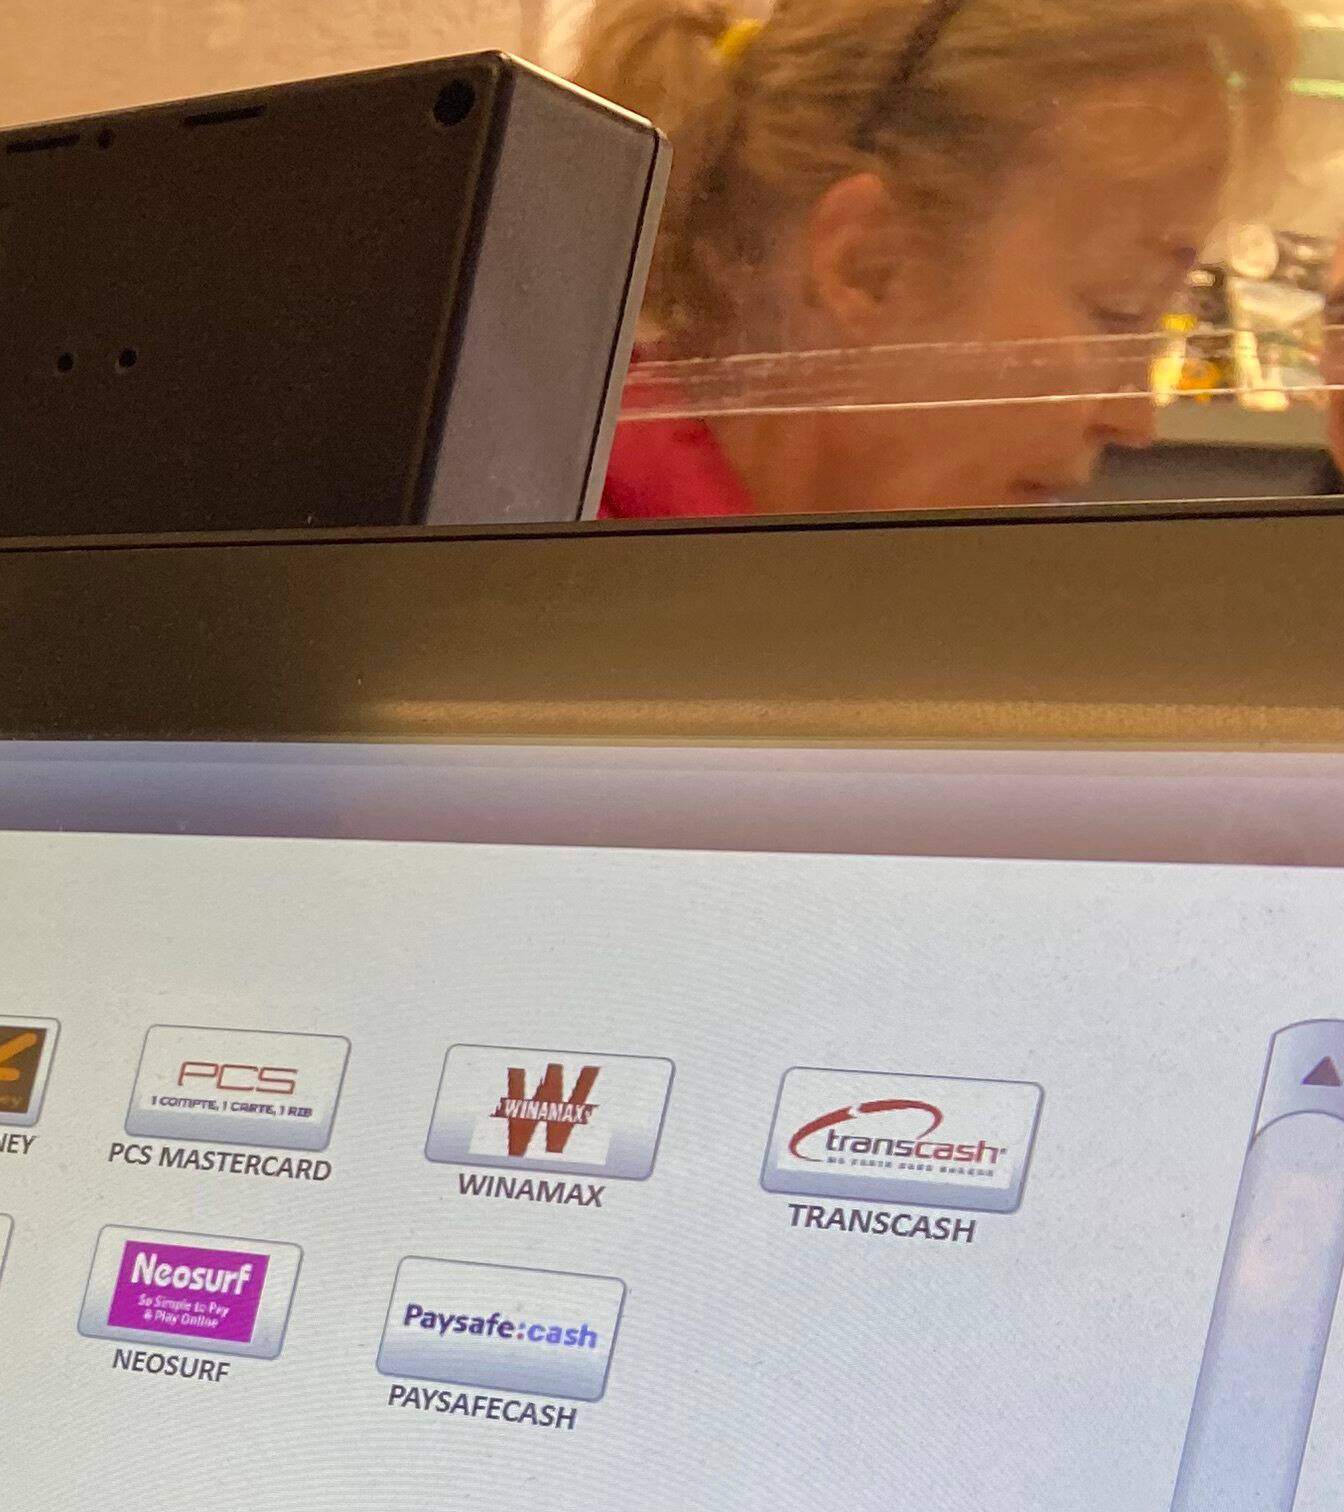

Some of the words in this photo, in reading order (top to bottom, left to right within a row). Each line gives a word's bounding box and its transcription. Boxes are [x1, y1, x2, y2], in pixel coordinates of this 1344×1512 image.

[178, 1061, 298, 1096] PCS
[504, 1098, 589, 1123] WINAMAX
[108, 1142, 154, 1168] PCS
[158, 1146, 332, 1182] MASTERCARD
[825, 1128, 1000, 1164] transcash
[457, 1172, 605, 1208] WINAMAX
[787, 1202, 976, 1245] TRANSCASH
[131, 1251, 253, 1295] Neosurf
[402, 1302, 598, 1350] Paysafe:cash
[112, 1348, 231, 1383] NEOSURF
[387, 1383, 577, 1431] PAYSAFECASH
